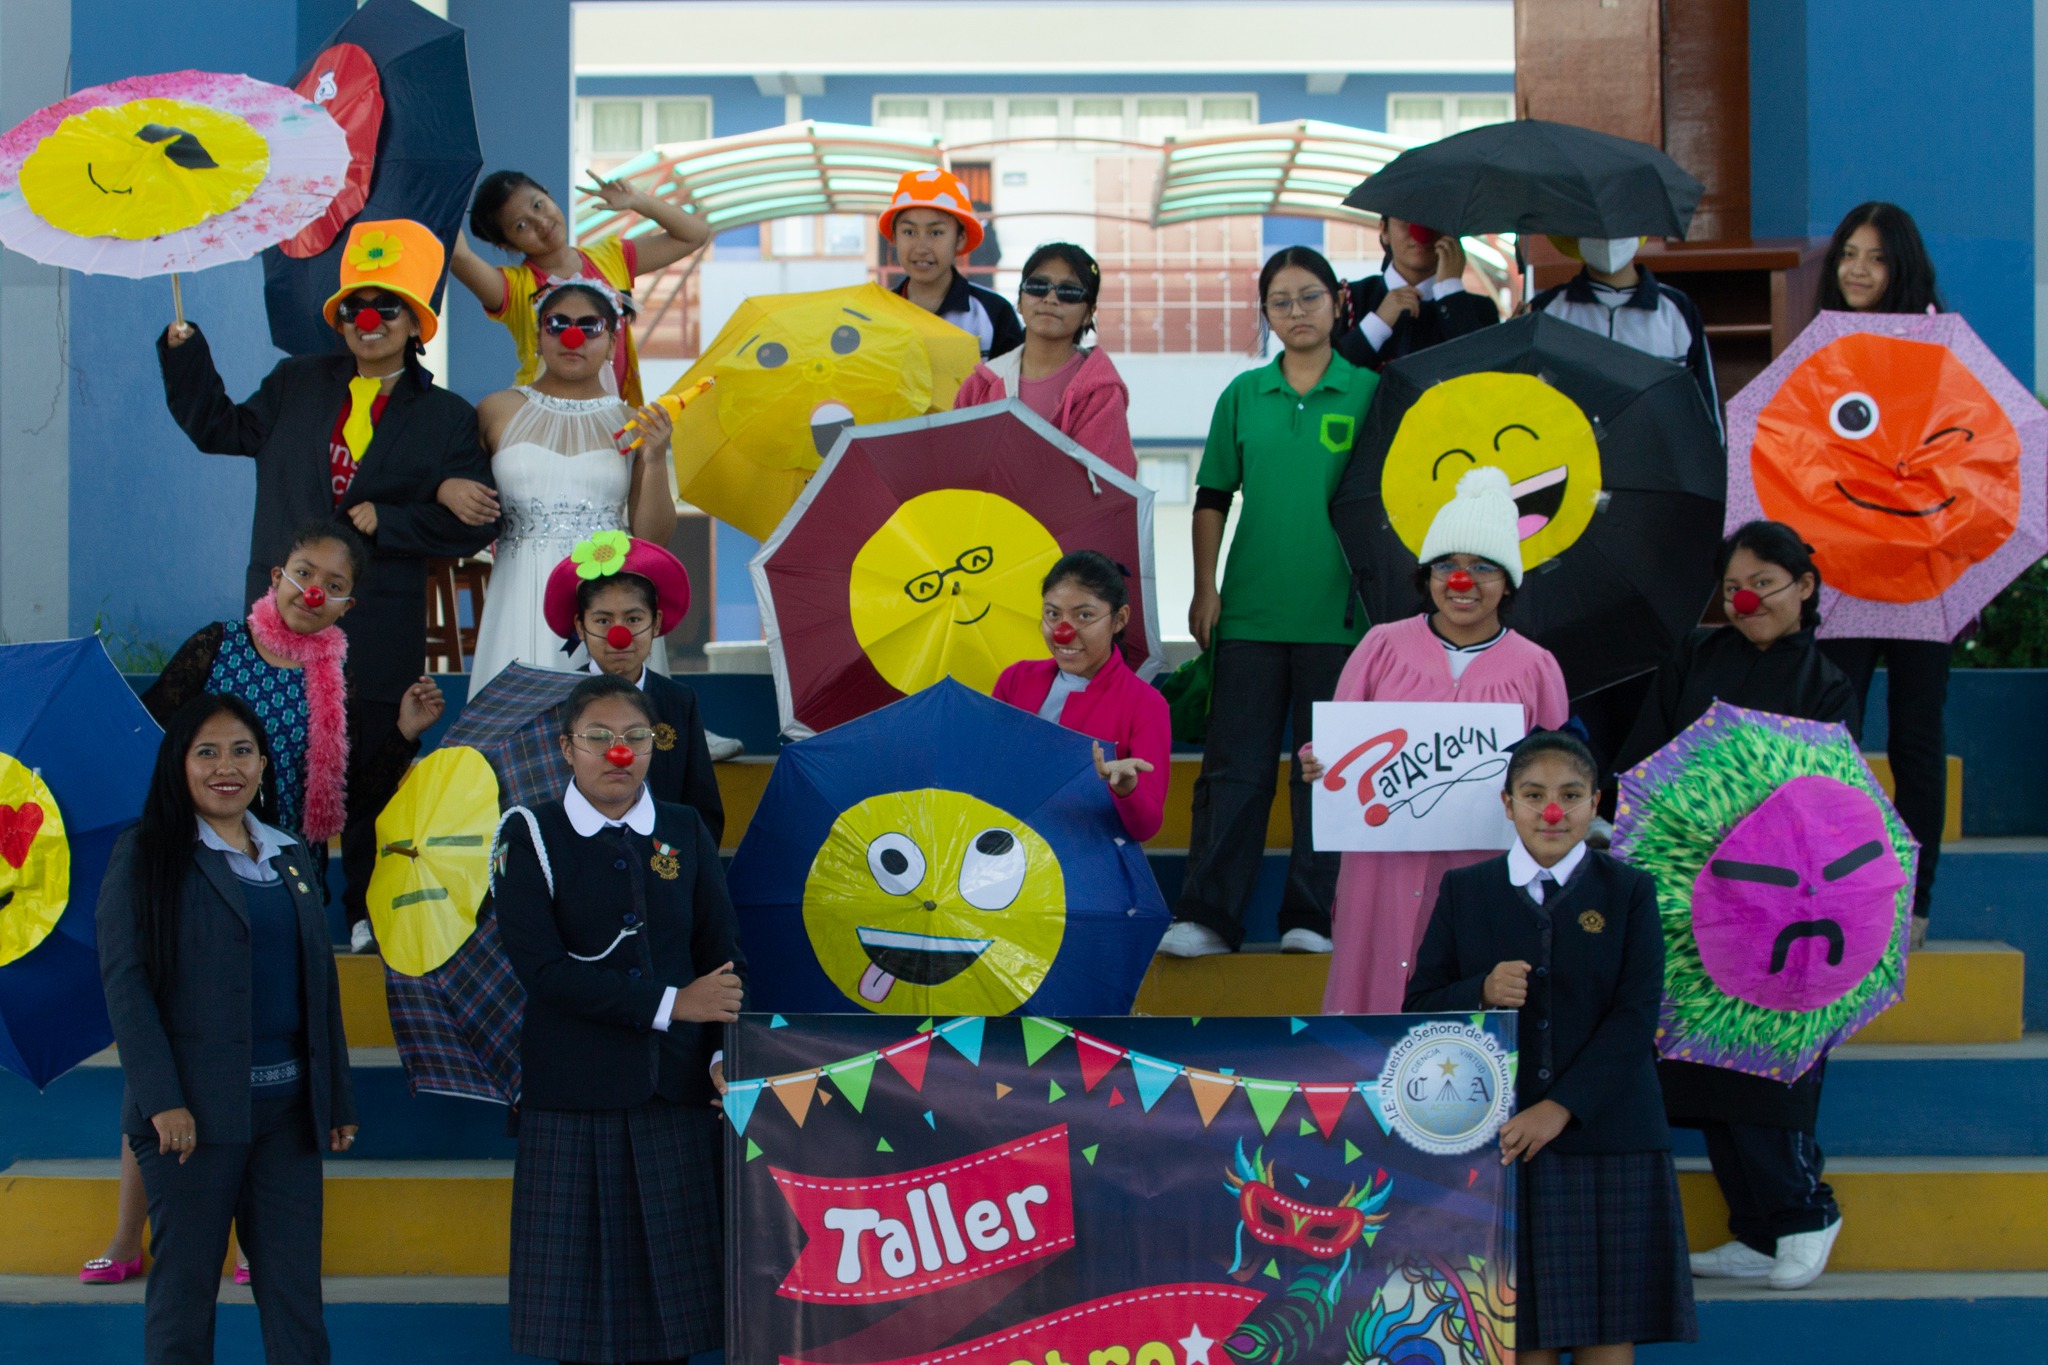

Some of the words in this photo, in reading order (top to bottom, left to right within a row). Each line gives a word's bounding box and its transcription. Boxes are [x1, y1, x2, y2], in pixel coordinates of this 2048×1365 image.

[1413, 1024, 1461, 1041] Señora
[1466, 1028, 1483, 1042] de
[1483, 1037, 1496, 1052] la
[1411, 1048, 1441, 1074] CIENCIA
[1459, 1048, 1486, 1075] VIRTUD
[823, 1182, 1049, 1284] Taller
